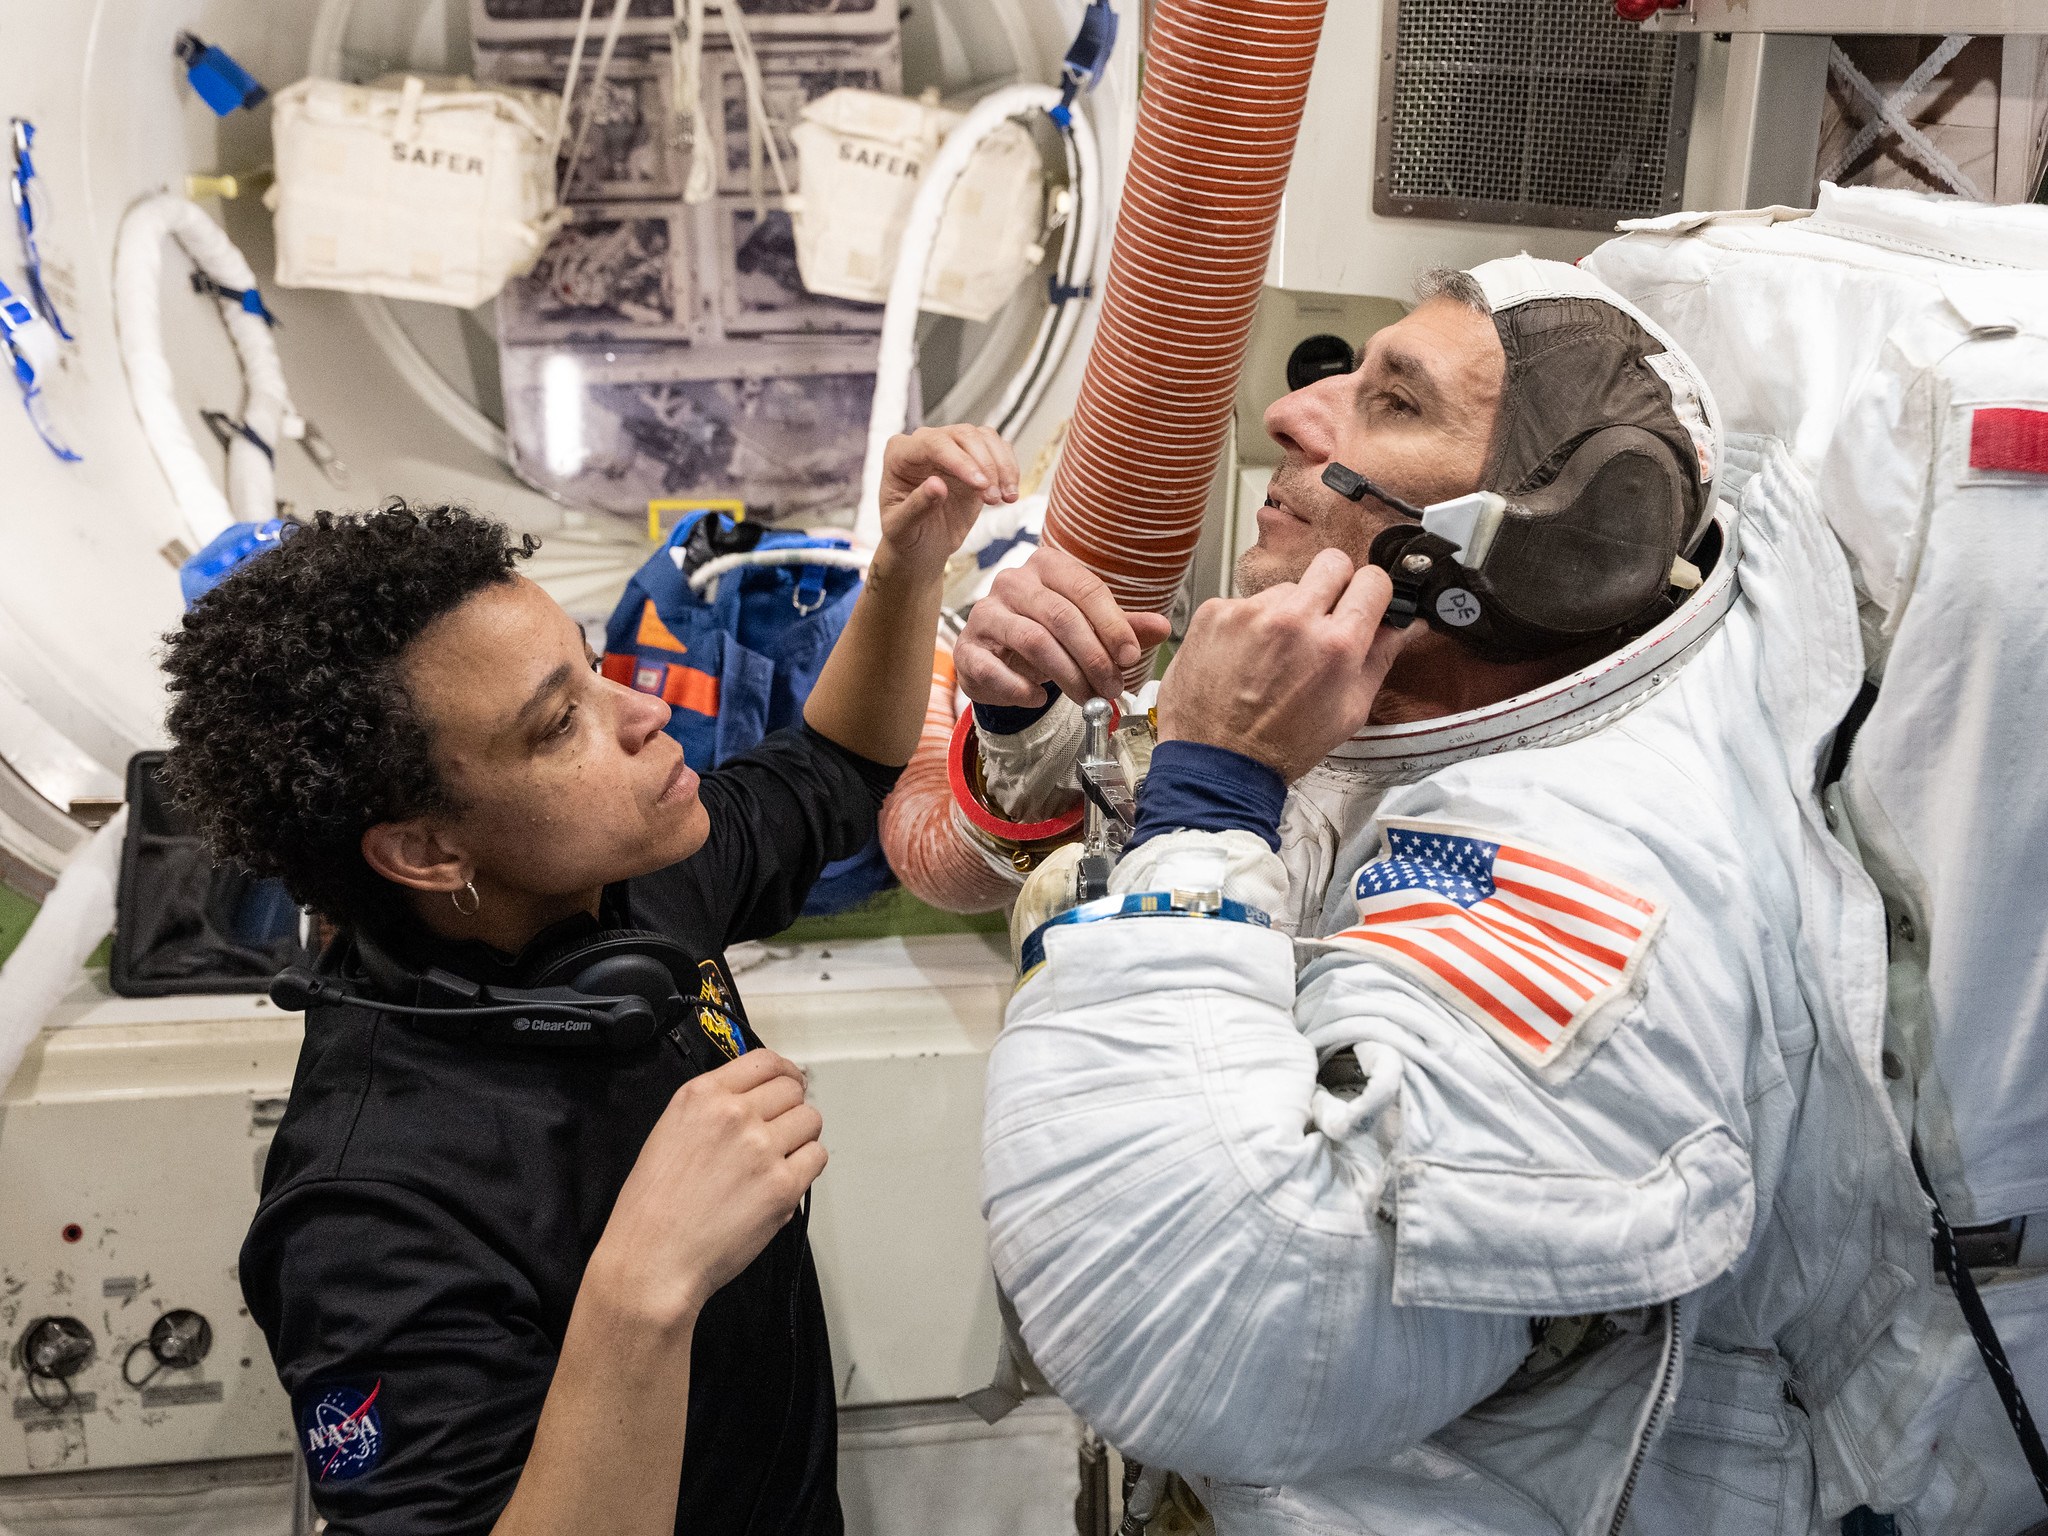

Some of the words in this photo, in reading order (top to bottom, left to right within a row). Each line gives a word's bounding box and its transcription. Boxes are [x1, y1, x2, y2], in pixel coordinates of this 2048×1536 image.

[392, 141, 484, 177] SAFER
[839, 142, 920, 179] SAFER
[531, 1019, 592, 1031] Clear-Com
[307, 1414, 378, 1451] NASA
